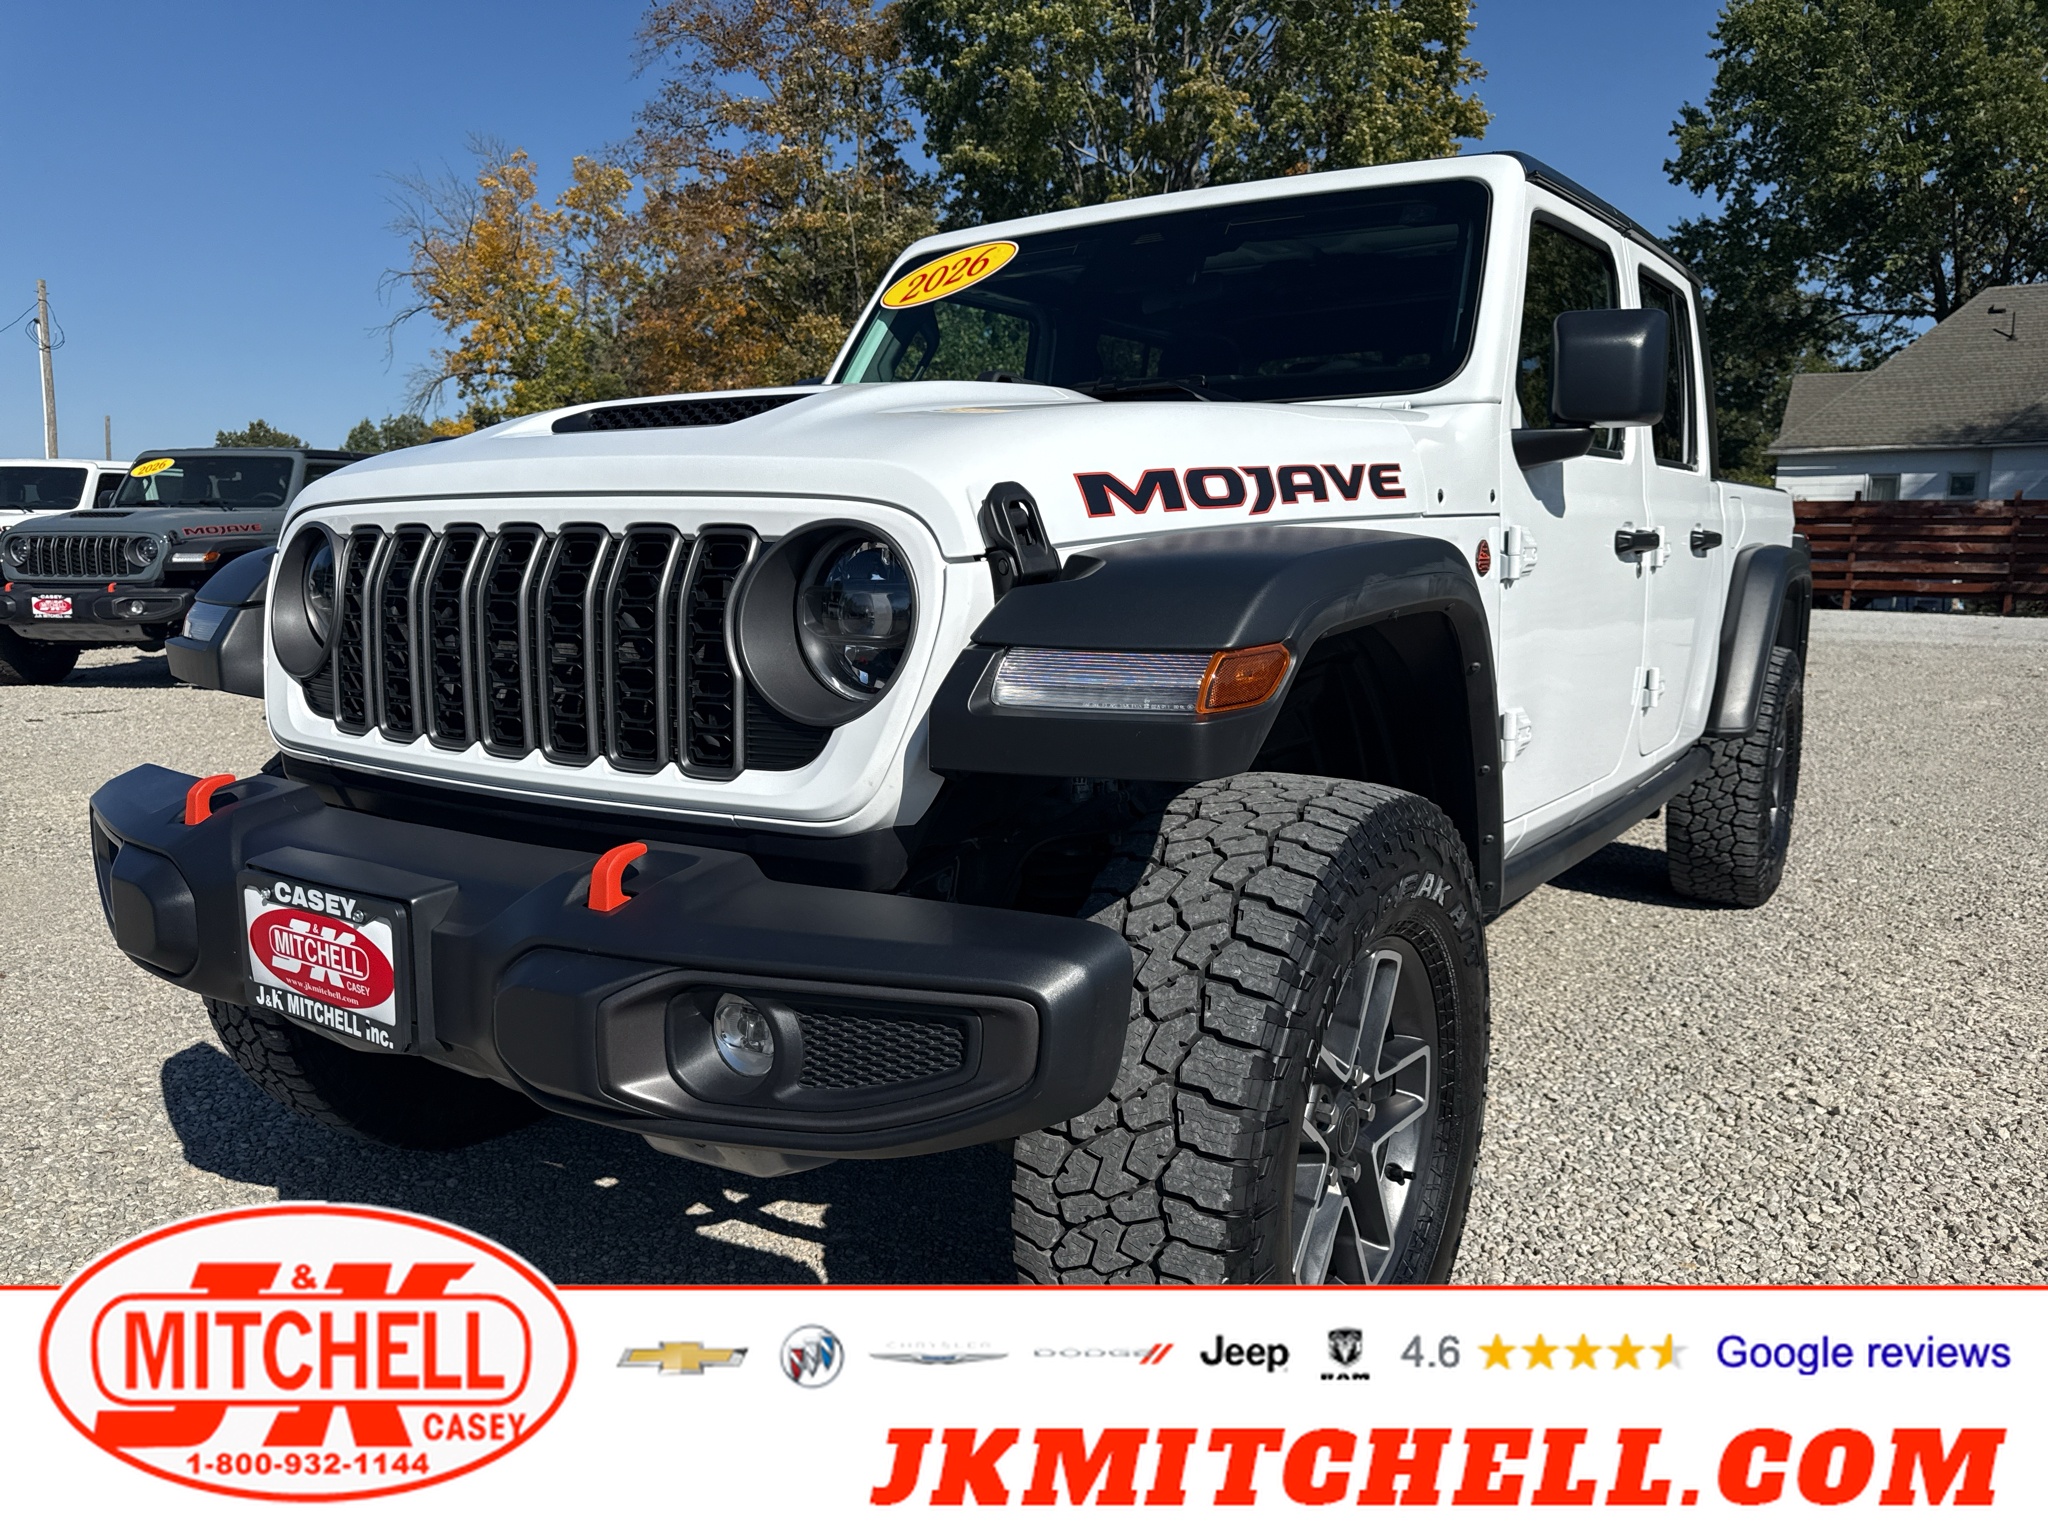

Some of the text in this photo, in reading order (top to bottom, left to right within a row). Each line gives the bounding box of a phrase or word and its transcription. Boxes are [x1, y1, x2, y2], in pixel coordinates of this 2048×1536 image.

[899, 246, 998, 304] 2026
[137, 461, 167, 476] 2026
[1073, 463, 1406, 518] MOJAVE
[182, 523, 262, 537] MOJAVE
[274, 881, 356, 919] CASEY
[273, 928, 364, 977] MITCHELL
[286, 976, 359, 1006] www.jkmitchell.com
[346, 980, 370, 997] CASEY
[256, 985, 284, 1011] J&K
[287, 993, 361, 1036] MITCHELL
